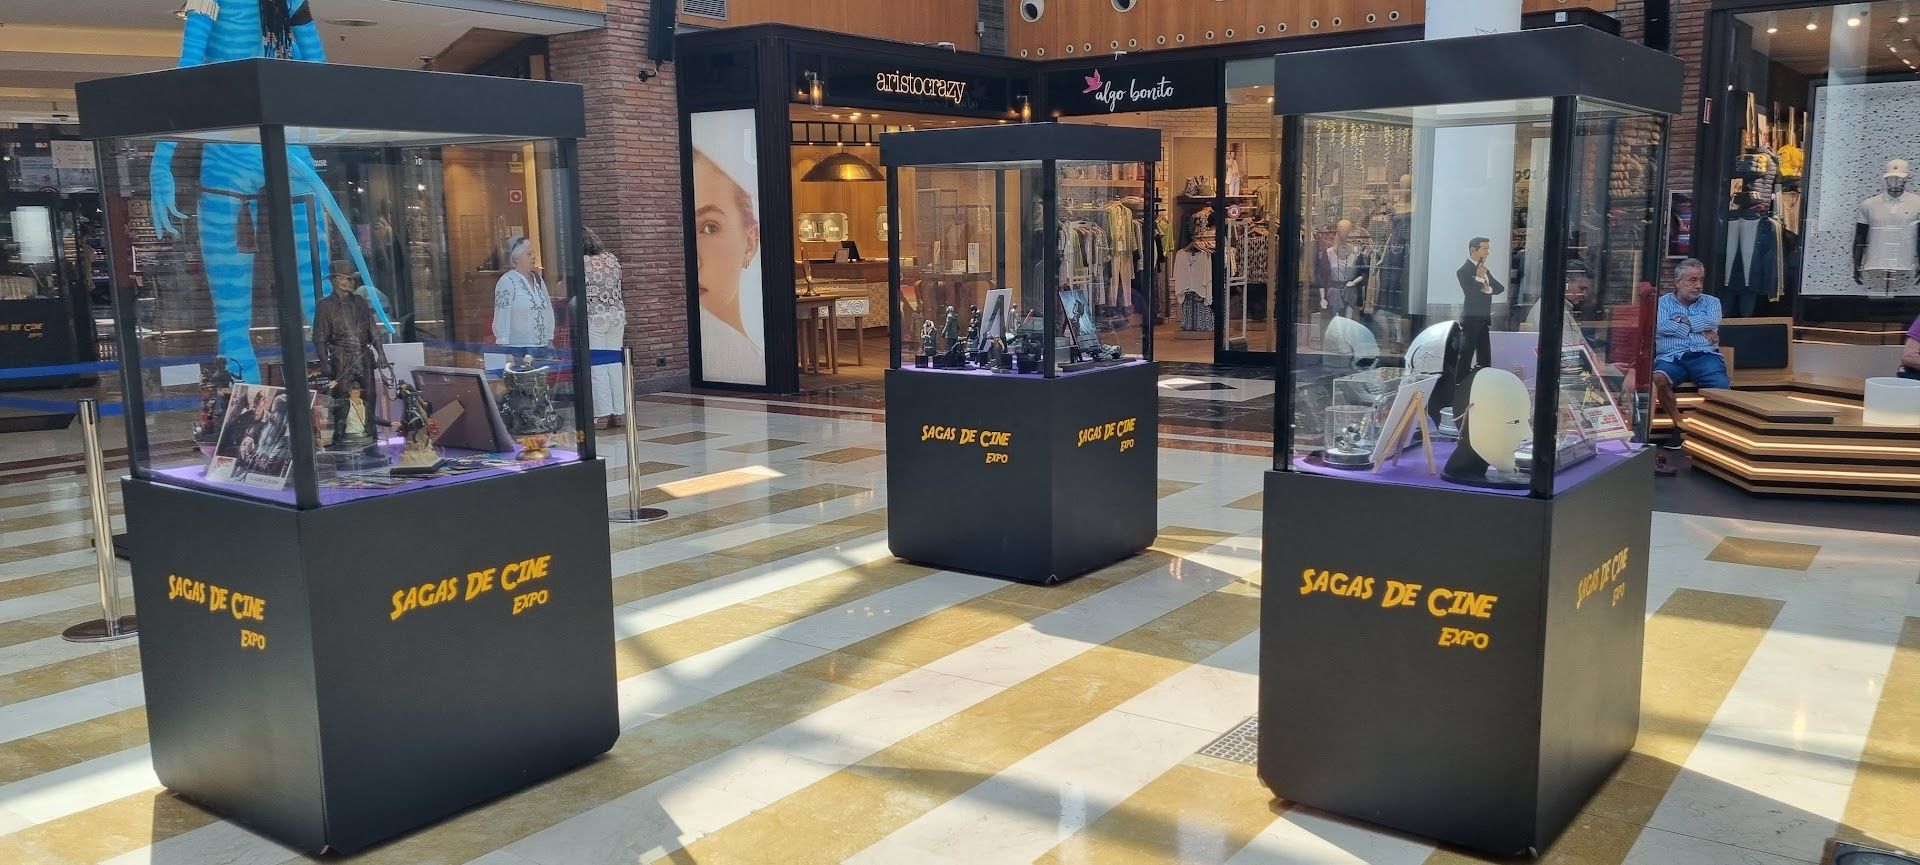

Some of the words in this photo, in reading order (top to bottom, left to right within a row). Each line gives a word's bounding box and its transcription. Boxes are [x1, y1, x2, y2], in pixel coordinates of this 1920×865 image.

[876, 70, 966, 104] aristocrazy
[1095, 80, 1127, 112] algo
[1129, 76, 1174, 102] bonito
[921, 425, 957, 441] SAGAS
[959, 428, 977, 445] DE
[979, 430, 1012, 448] CINE
[1077, 425, 1103, 447] SAGAS
[1103, 422, 1117, 441] DE
[1116, 417, 1137, 438] CINE
[1119, 439, 1135, 452] EXPO
[985, 452, 1009, 464] EXPO
[389, 576, 460, 621] SAGAS
[464, 567, 498, 602] DE
[500, 554, 552, 592] CINE
[1576, 567, 1600, 609] SAGAS
[1600, 558, 1613, 591] DE
[1611, 547, 1629, 582] CINE
[168, 574, 207, 604] SAGAS
[208, 584, 230, 612] DE
[230, 591, 266, 622] CINE
[512, 589, 551, 616] EXPO
[1298, 568, 1376, 600] SAGAS
[1380, 579, 1423, 609] DE
[1426, 587, 1499, 620] CINE
[240, 628, 267, 651] EXPO
[1437, 625, 1490, 651] EXPO
